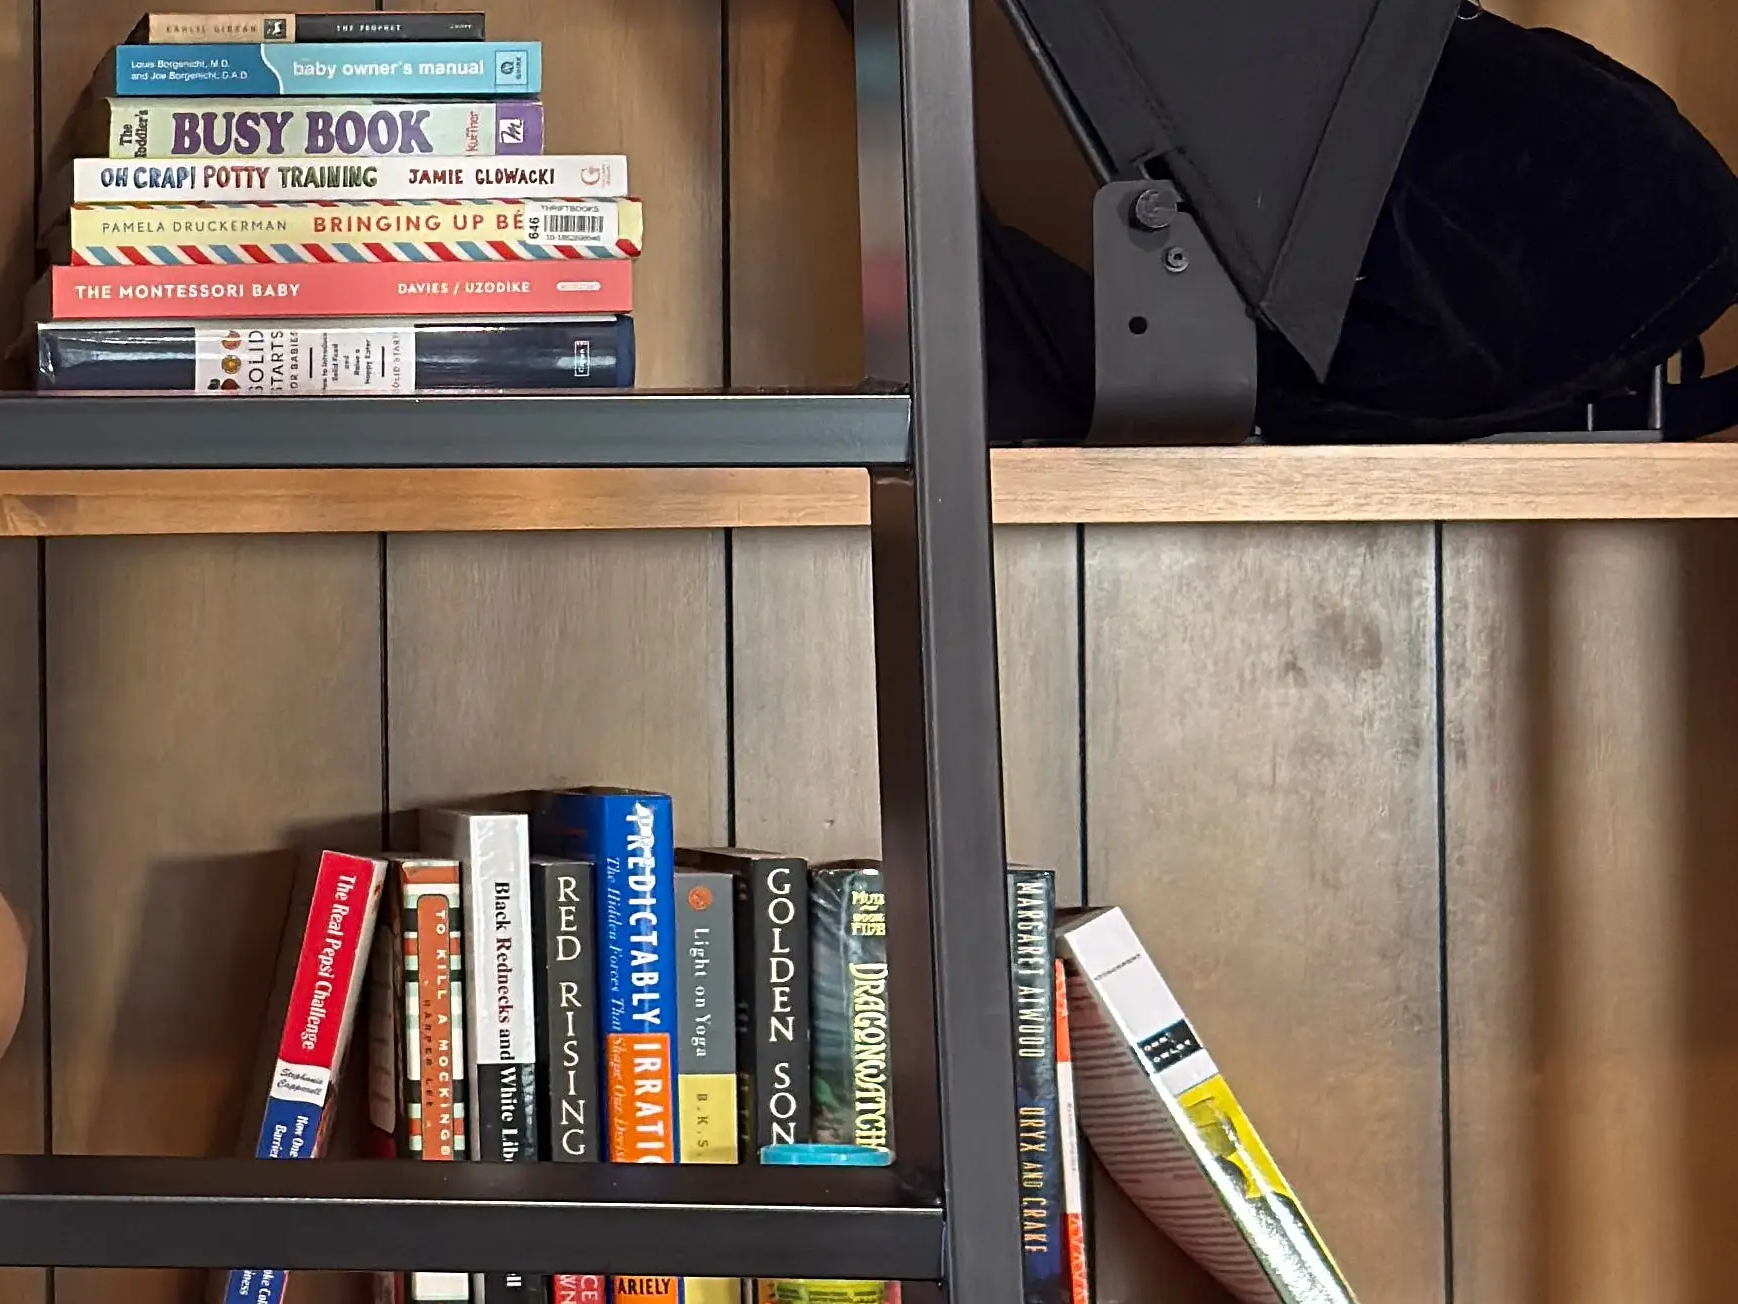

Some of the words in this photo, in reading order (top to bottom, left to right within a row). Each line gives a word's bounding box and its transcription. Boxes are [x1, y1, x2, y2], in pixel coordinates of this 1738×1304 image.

[131, 60, 155, 69] Louis
[157, 60, 207, 70] Borgenicht,
[293, 61, 335, 79] baby
[341, 61, 413, 76] owner's
[419, 60, 484, 76] manual
[171, 112, 294, 156] BUSY
[304, 110, 433, 156] BOOK
[101, 166, 129, 188] OH
[133, 166, 196, 190] CRAP!
[203, 165, 271, 189] POTTY
[277, 165, 378, 189] TRAINING
[409, 168, 463, 184] JAMIE
[475, 168, 555, 184] GLOWACKI
[529, 216, 539, 240] 646
[75, 284, 111, 299] THE
[119, 284, 245, 298] MONTESSORI
[253, 283, 301, 298] BABY
[398, 282, 449, 294] DAVIES
[465, 282, 530, 294] UZODIKE
[332, 874, 356, 900] The
[493, 881, 511, 931] Black
[326, 904, 350, 942] Real
[557, 876, 581, 962] RED
[315, 938, 342, 978] Pepsi
[767, 868, 795, 1043] GOLDEN
[495, 936, 513, 1025] Rednecks
[301, 978, 333, 1052] Challenge
[499, 1028, 515, 1061] and
[559, 982, 586, 1156] RISING
[499, 1067, 517, 1122] White
[770, 1062, 797, 1146] SON
[618, 1278, 671, 1296] ARIELY
